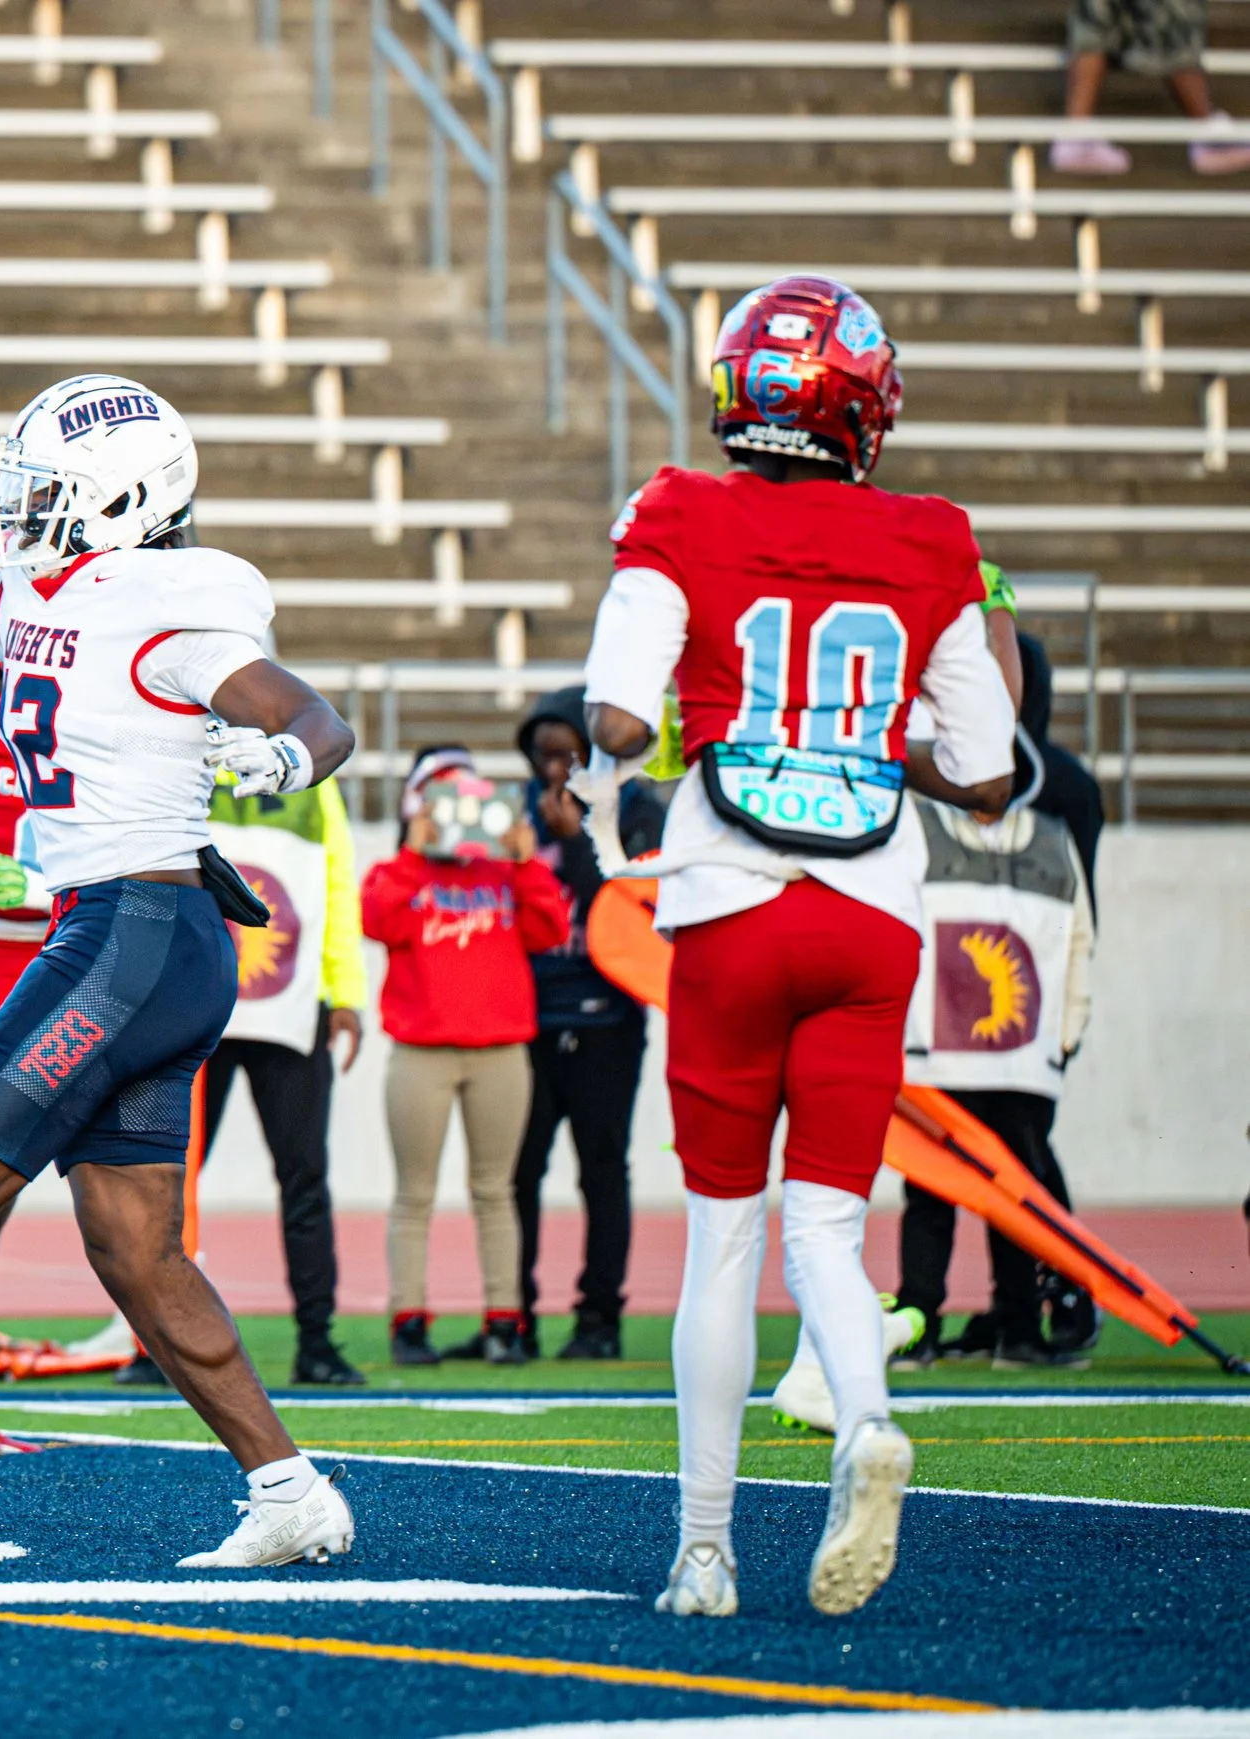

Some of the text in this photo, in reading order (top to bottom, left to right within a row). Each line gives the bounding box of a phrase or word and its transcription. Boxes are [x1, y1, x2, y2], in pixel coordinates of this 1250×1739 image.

[57, 395, 159, 436] KNIGHTS
[4, 618, 81, 669] NIGHTS
[725, 596, 909, 761] 10
[738, 788, 844, 828] DOG
[18, 1009, 104, 1088] 75233
[243, 1498, 327, 1563] BATTLE
